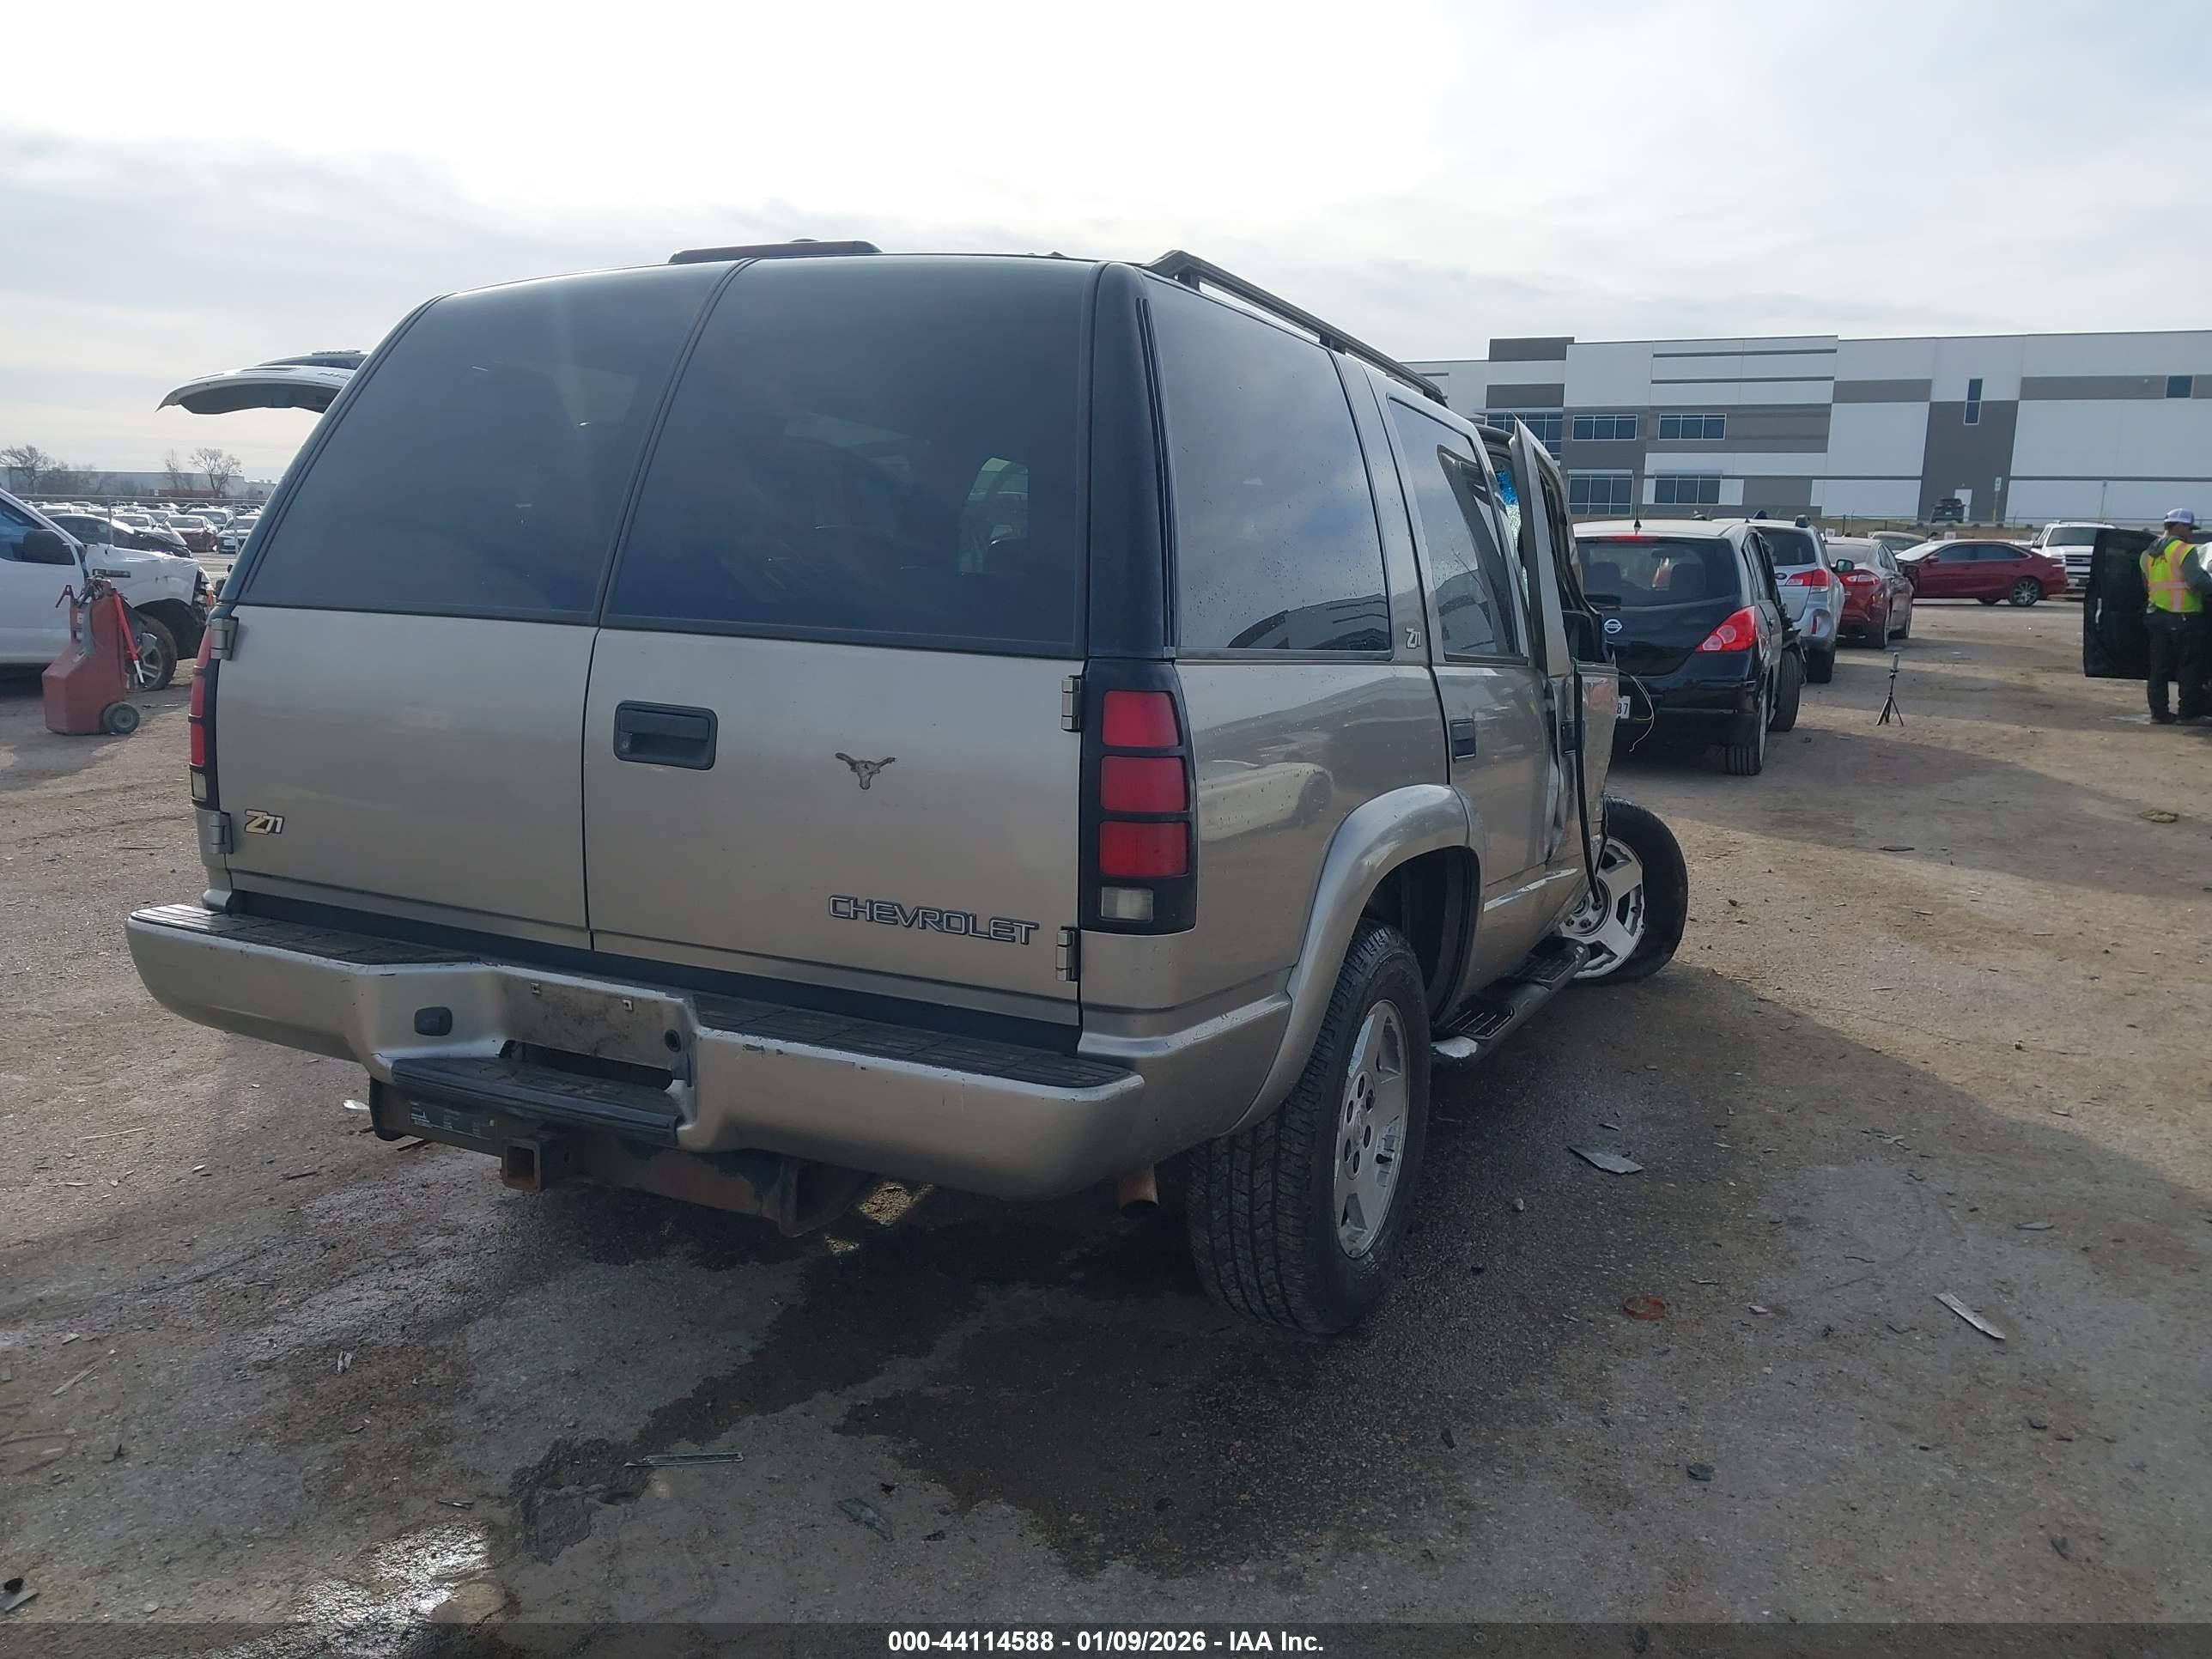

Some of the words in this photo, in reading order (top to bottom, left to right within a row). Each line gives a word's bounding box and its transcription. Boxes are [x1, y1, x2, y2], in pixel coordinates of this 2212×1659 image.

[1406, 628, 1421, 649] Z71
[245, 809, 284, 835] Z71
[829, 894, 1039, 945] CHEVROLET
